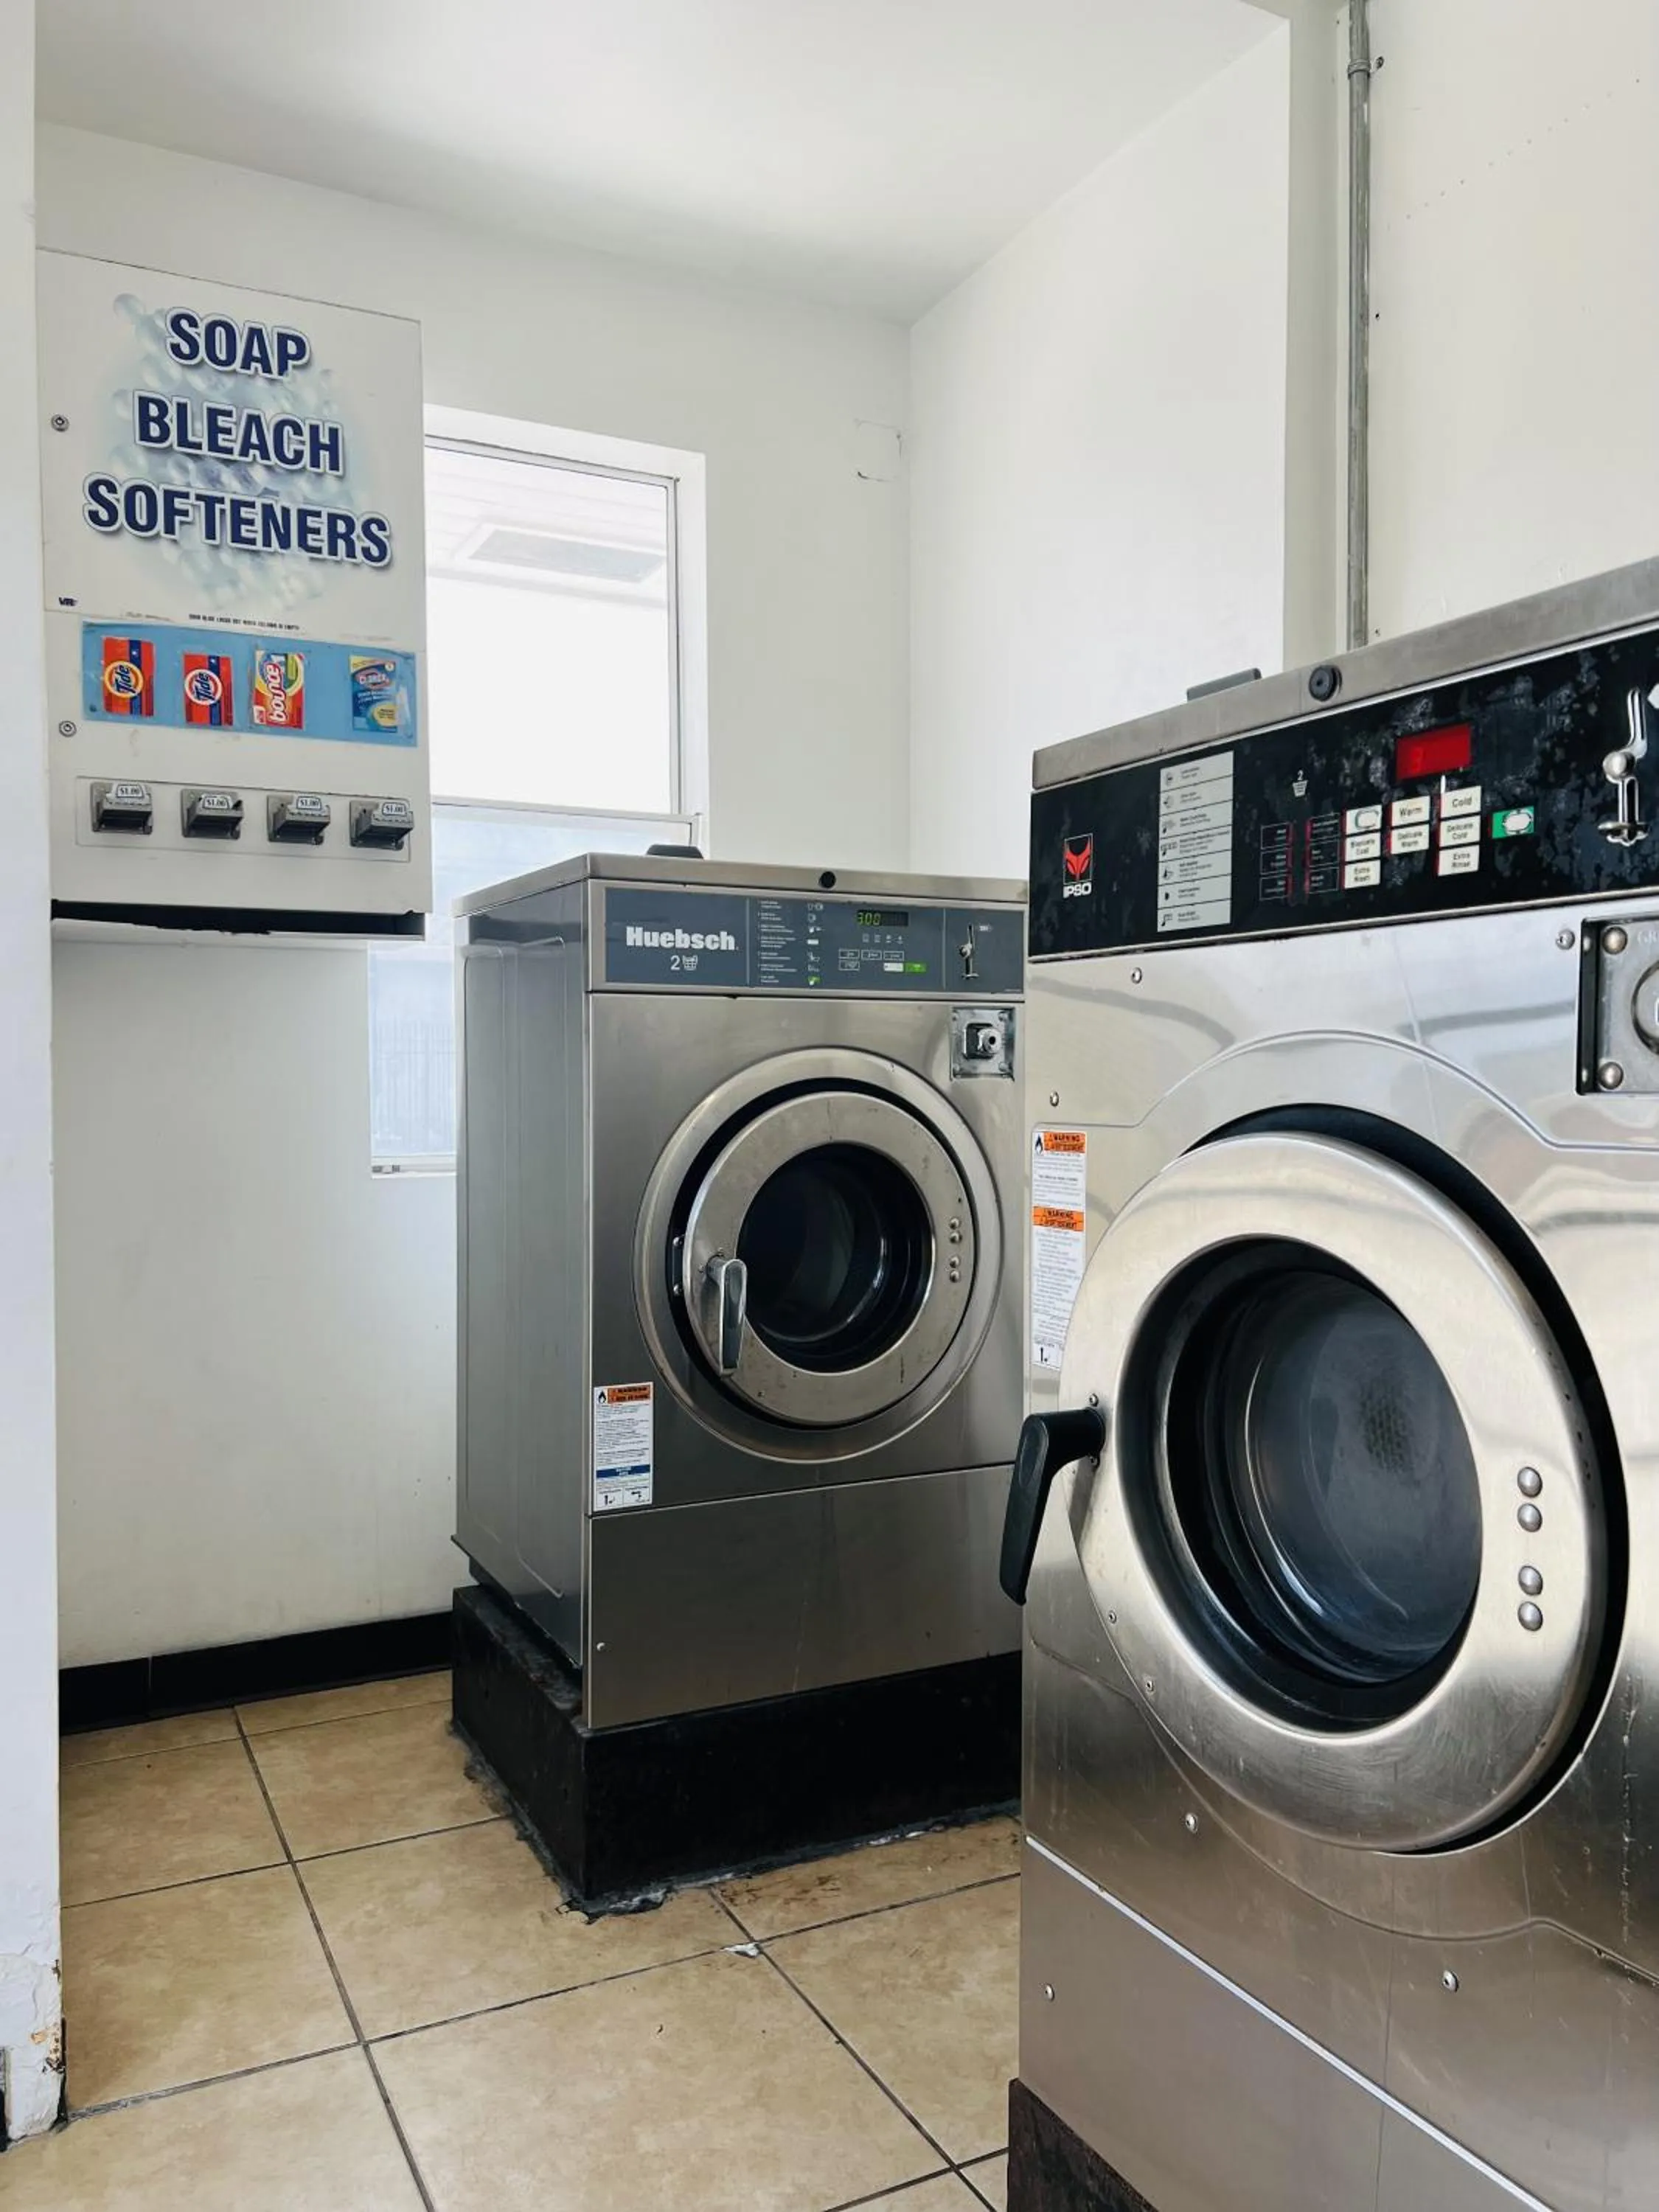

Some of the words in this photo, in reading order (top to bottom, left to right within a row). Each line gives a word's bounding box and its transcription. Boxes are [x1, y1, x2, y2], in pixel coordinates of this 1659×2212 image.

[167, 310, 310, 378] SOAP
[136, 393, 342, 474] BLEACH
[86, 476, 390, 564] SOFTENERS
[114, 664, 136, 694] Tide
[195, 672, 215, 701] Tide
[1297, 769, 1304, 780] 2
[1399, 806, 1423, 817] Warm
[1451, 796, 1473, 808] Cold
[1062, 882, 1092, 899] IPSO
[626, 926, 736, 950] Huebsch
[669, 955, 681, 971] 2
